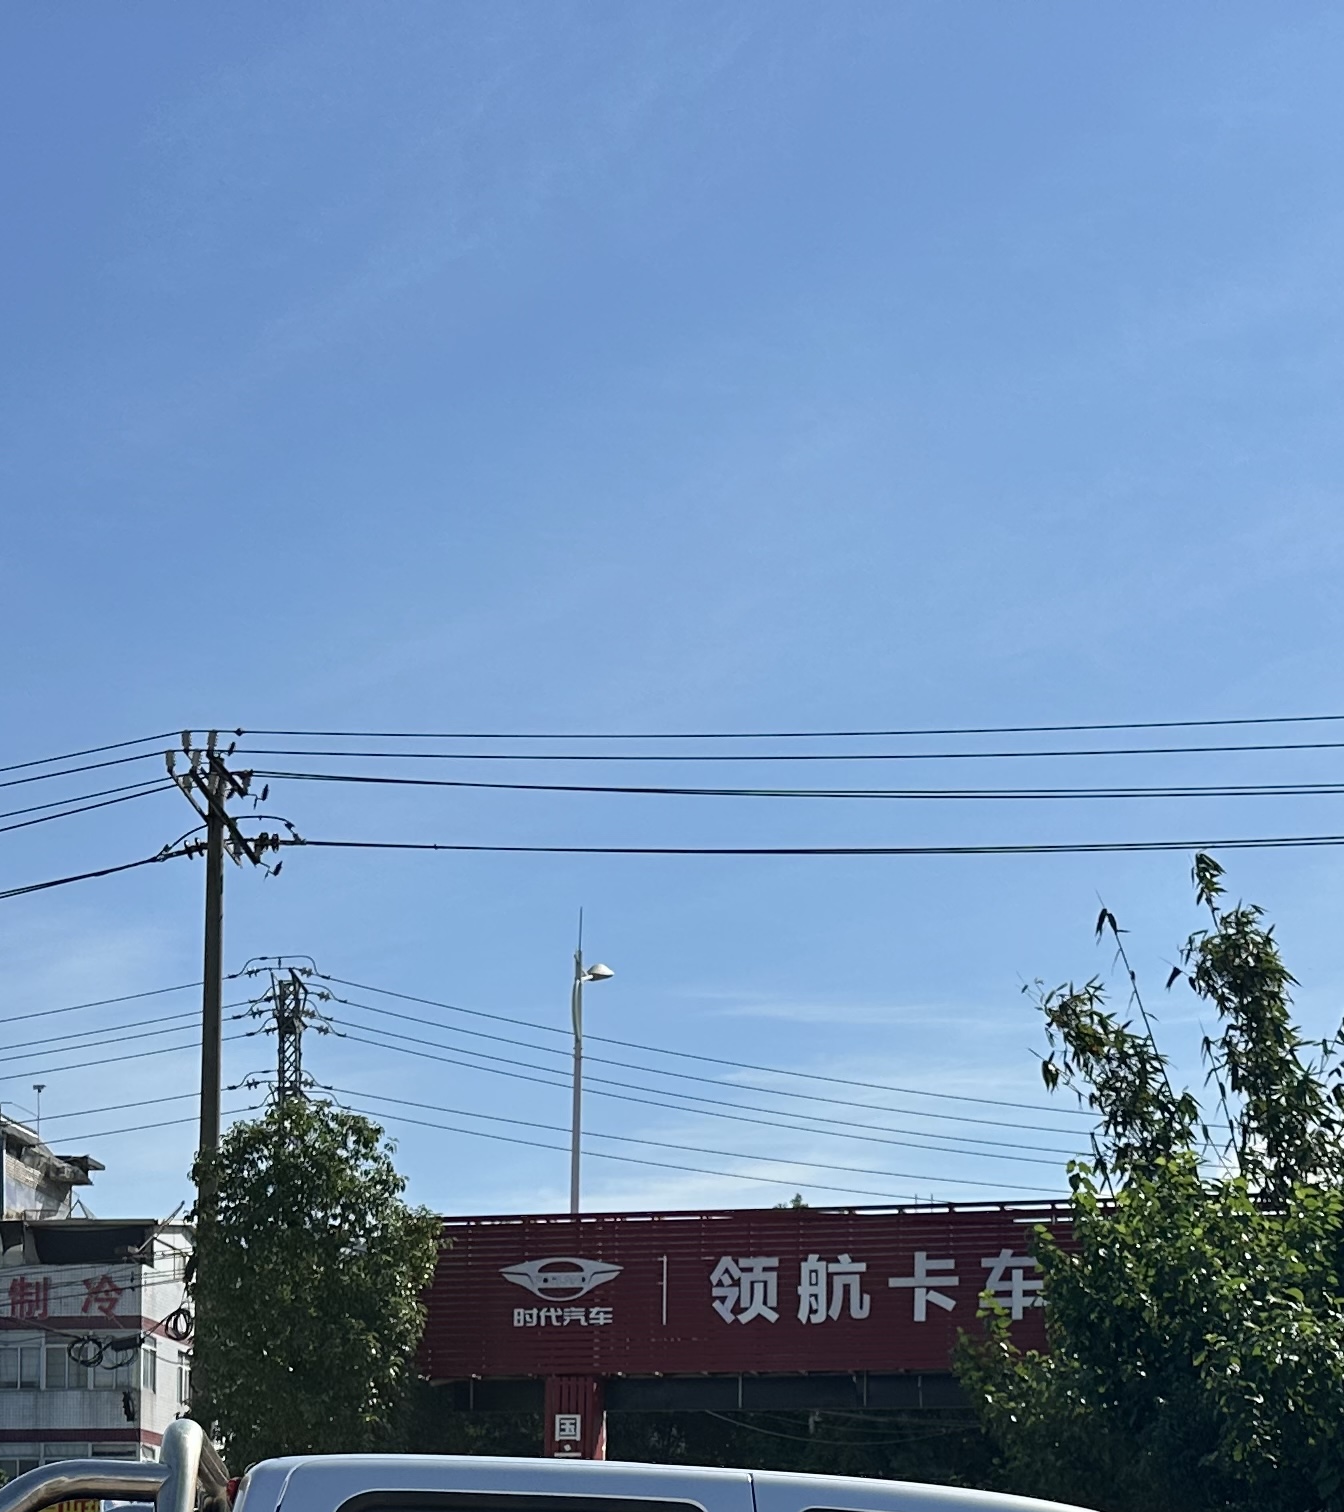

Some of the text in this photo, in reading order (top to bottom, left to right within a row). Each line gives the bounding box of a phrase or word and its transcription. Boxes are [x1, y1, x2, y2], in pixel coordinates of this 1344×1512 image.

[709, 1249, 1045, 1325] 领航卡车
[513, 1307, 613, 1327] 时代汽车
